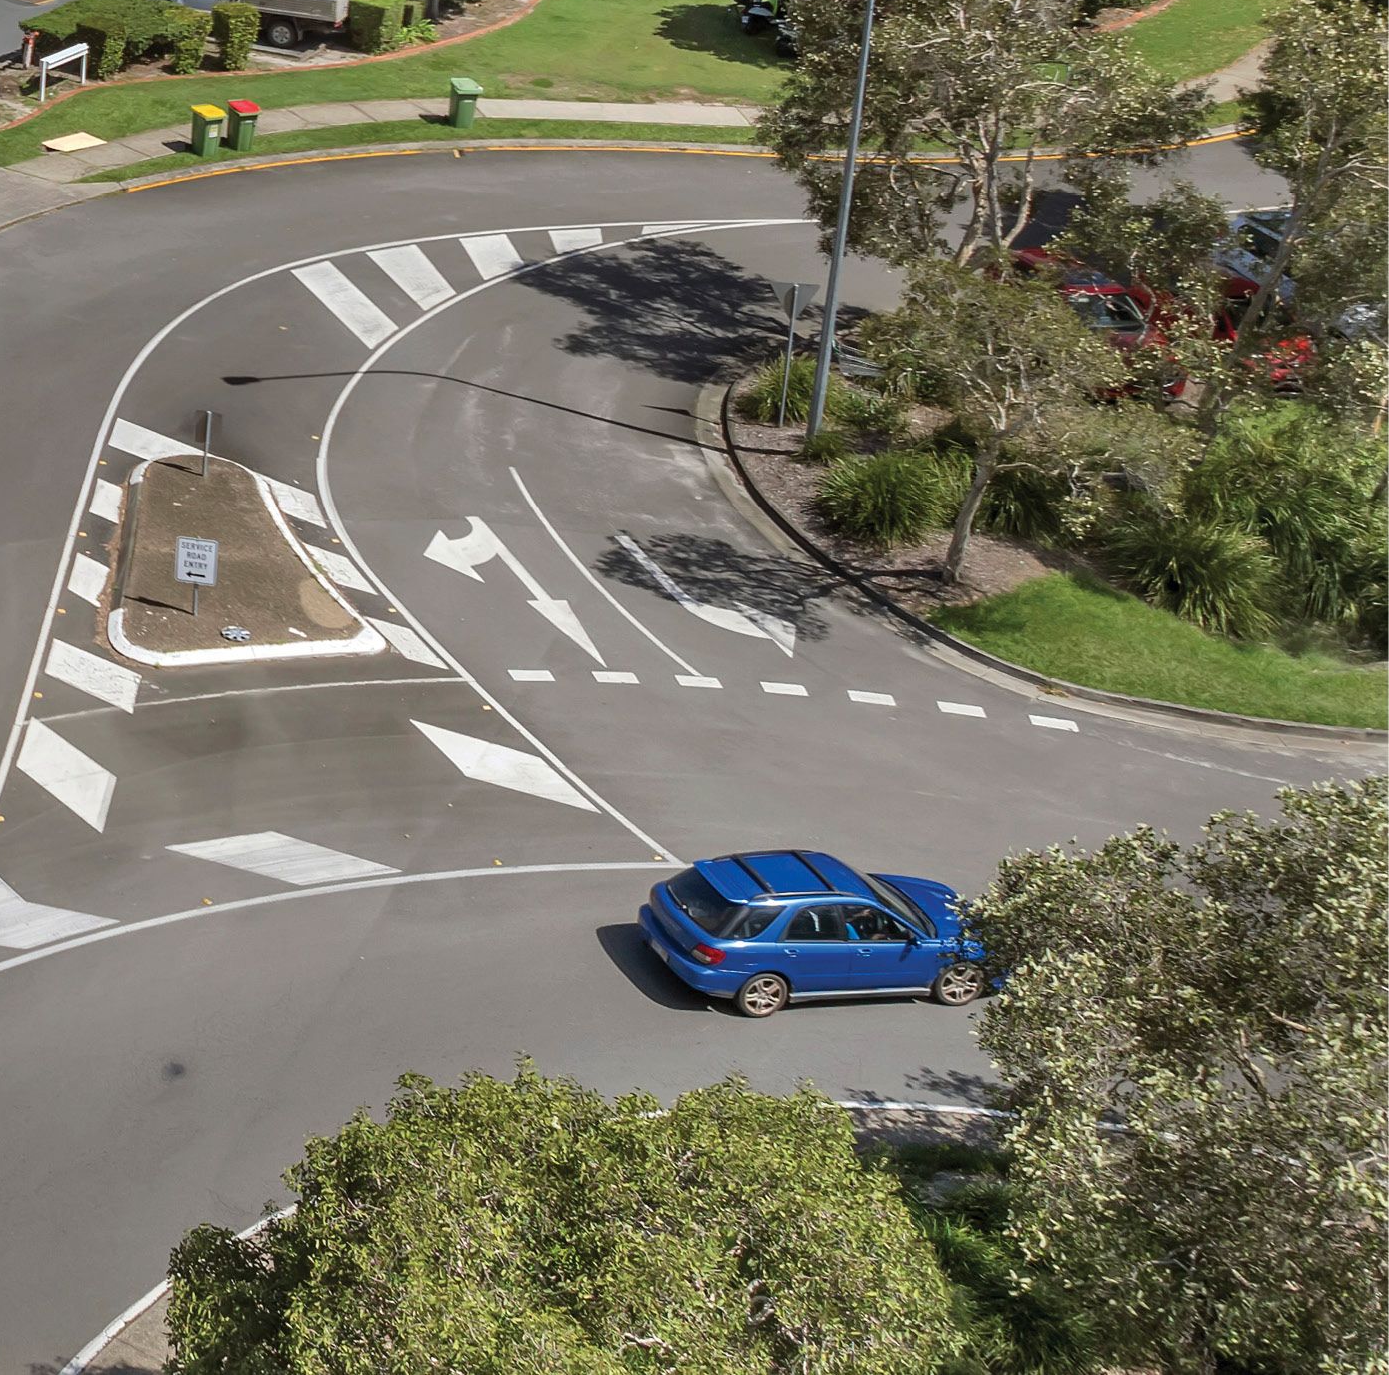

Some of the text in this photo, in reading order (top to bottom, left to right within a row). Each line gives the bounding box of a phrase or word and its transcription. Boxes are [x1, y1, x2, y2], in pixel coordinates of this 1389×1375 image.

[181, 542, 214, 553] SERVICE
[186, 551, 207, 561] ROAD
[183, 560, 208, 570] ENTRY
